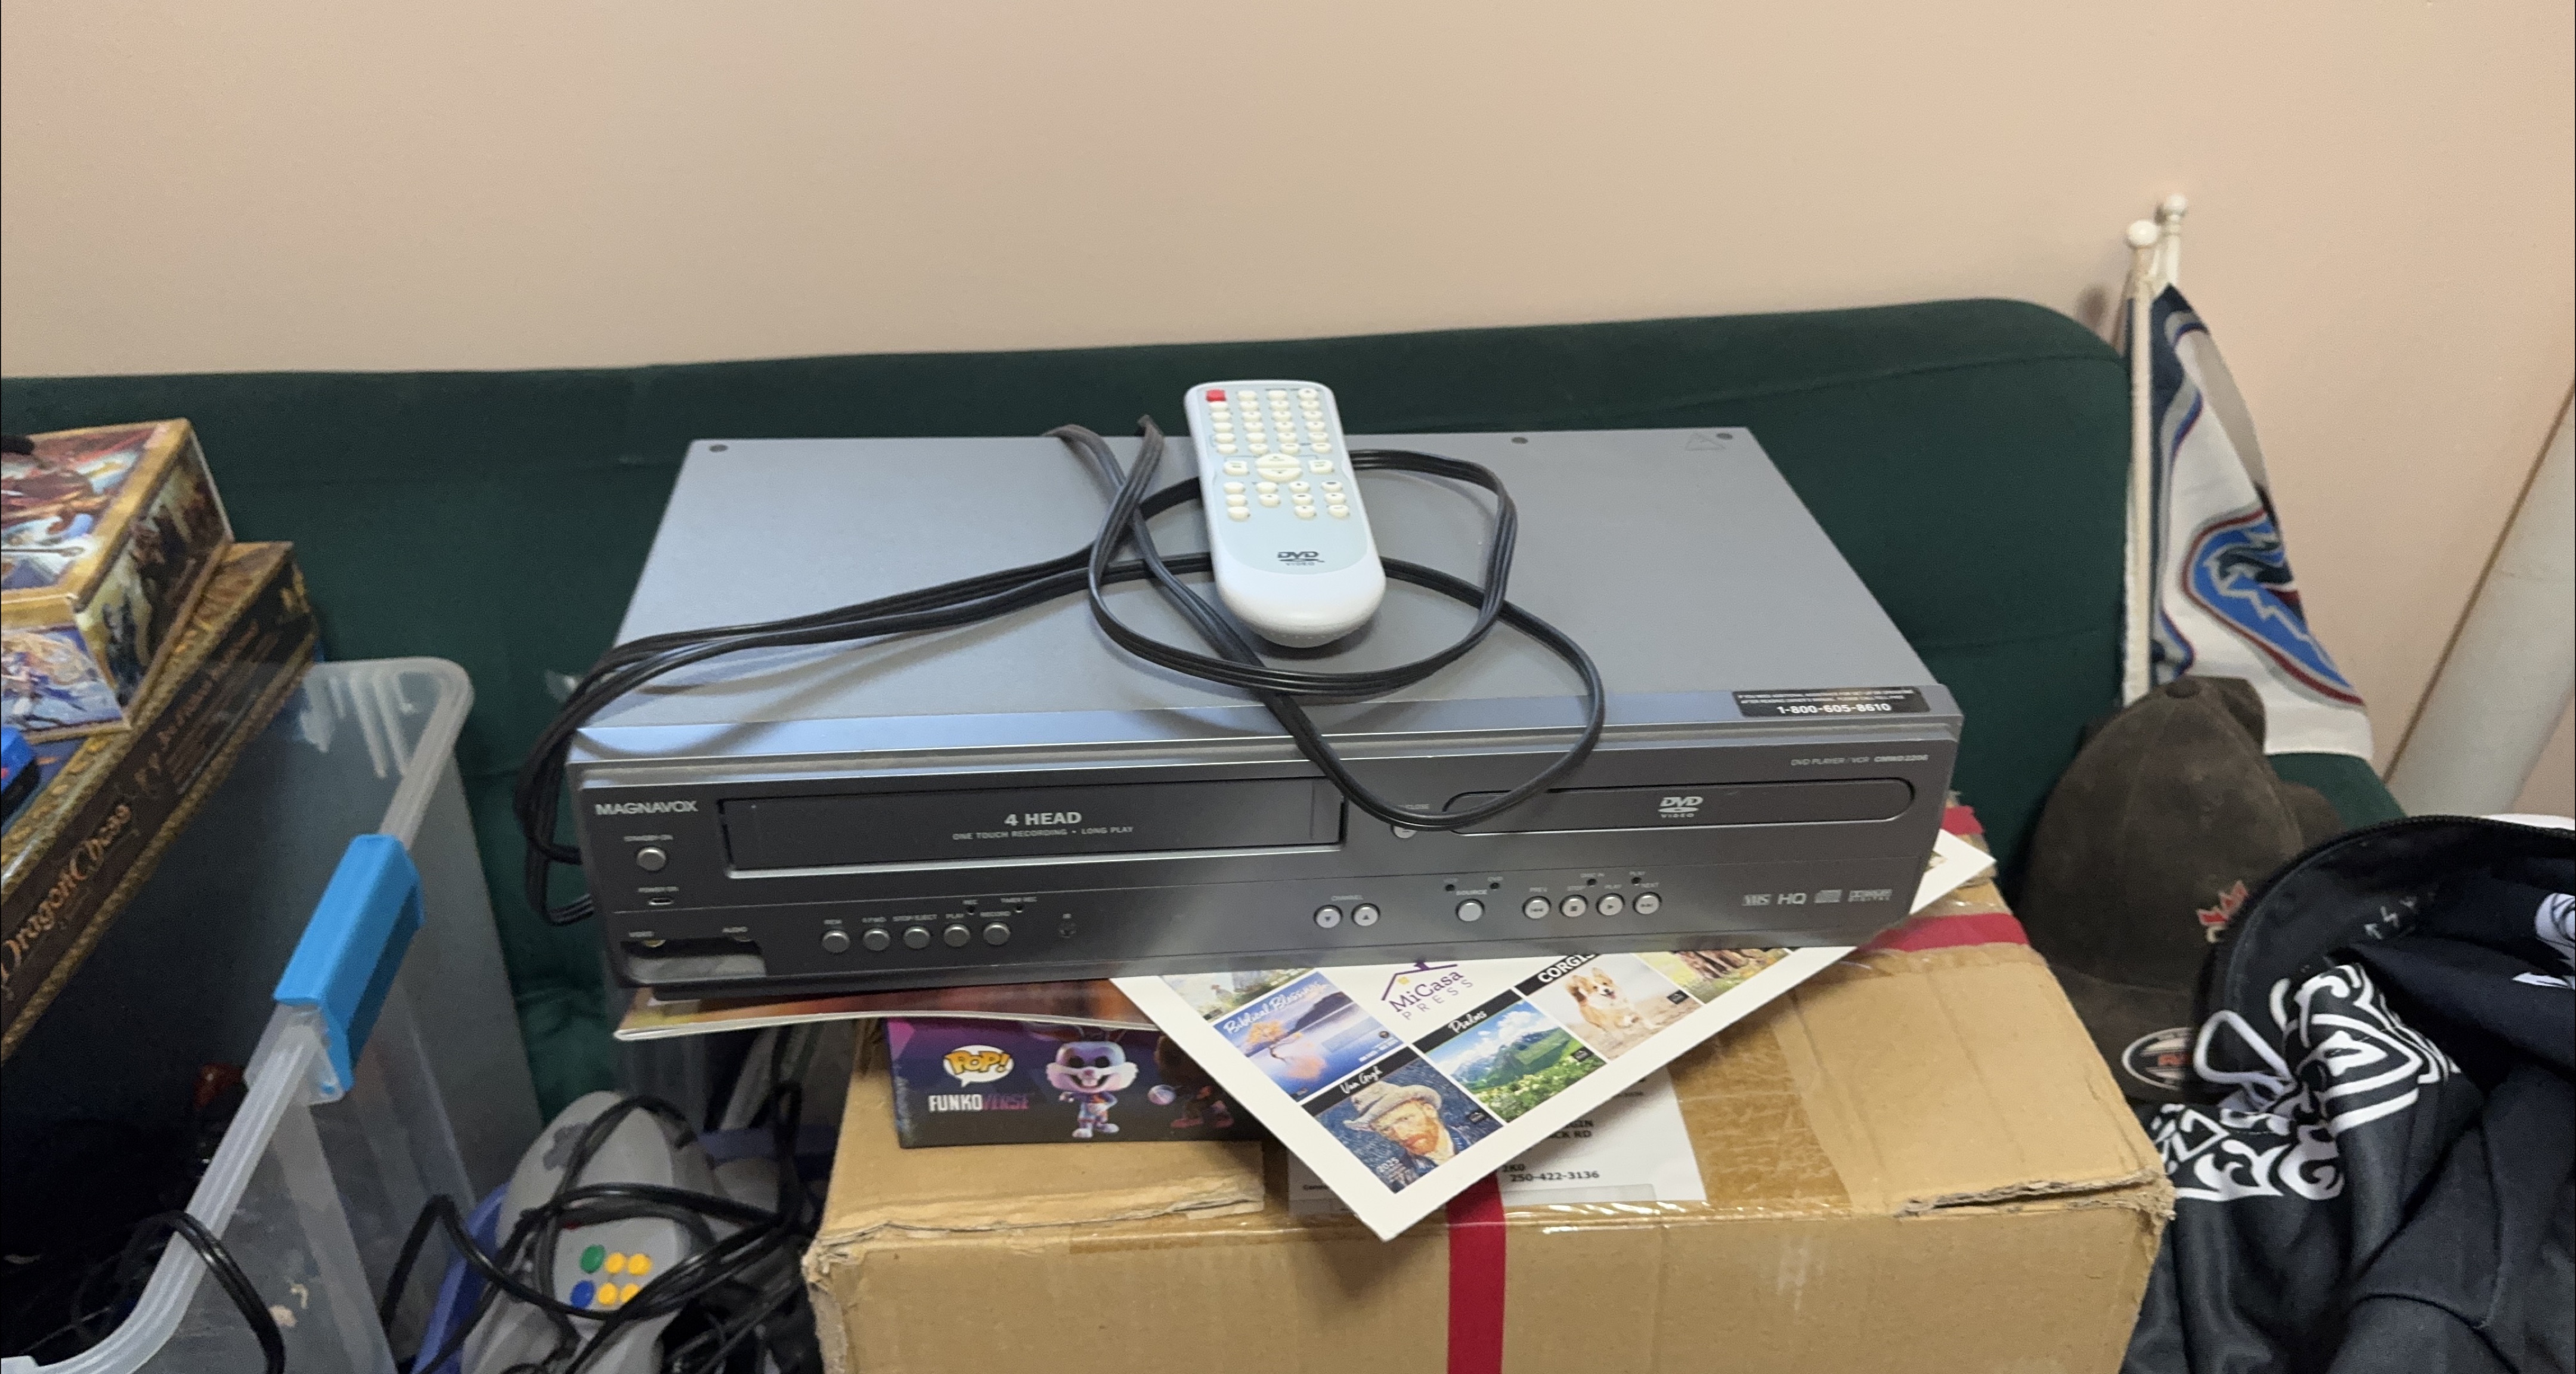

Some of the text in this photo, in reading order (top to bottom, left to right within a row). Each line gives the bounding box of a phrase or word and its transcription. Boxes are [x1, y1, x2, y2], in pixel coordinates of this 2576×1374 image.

[1777, 703, 1892, 714] 1-800-605-8610
[595, 801, 699, 815] MAGNAVOX
[1659, 796, 1704, 807] DVD
[1004, 812, 1082, 826] 4 HEAD
[1011, 829, 1068, 837] RECORDING
[1777, 892, 1807, 905] HQ
[1389, 971, 1465, 1013] MiCasa
[1401, 979, 1473, 1020] PRESS
[942, 1050, 1012, 1075] POP!
[1510, 1170, 1600, 1183] 250-422-3136
